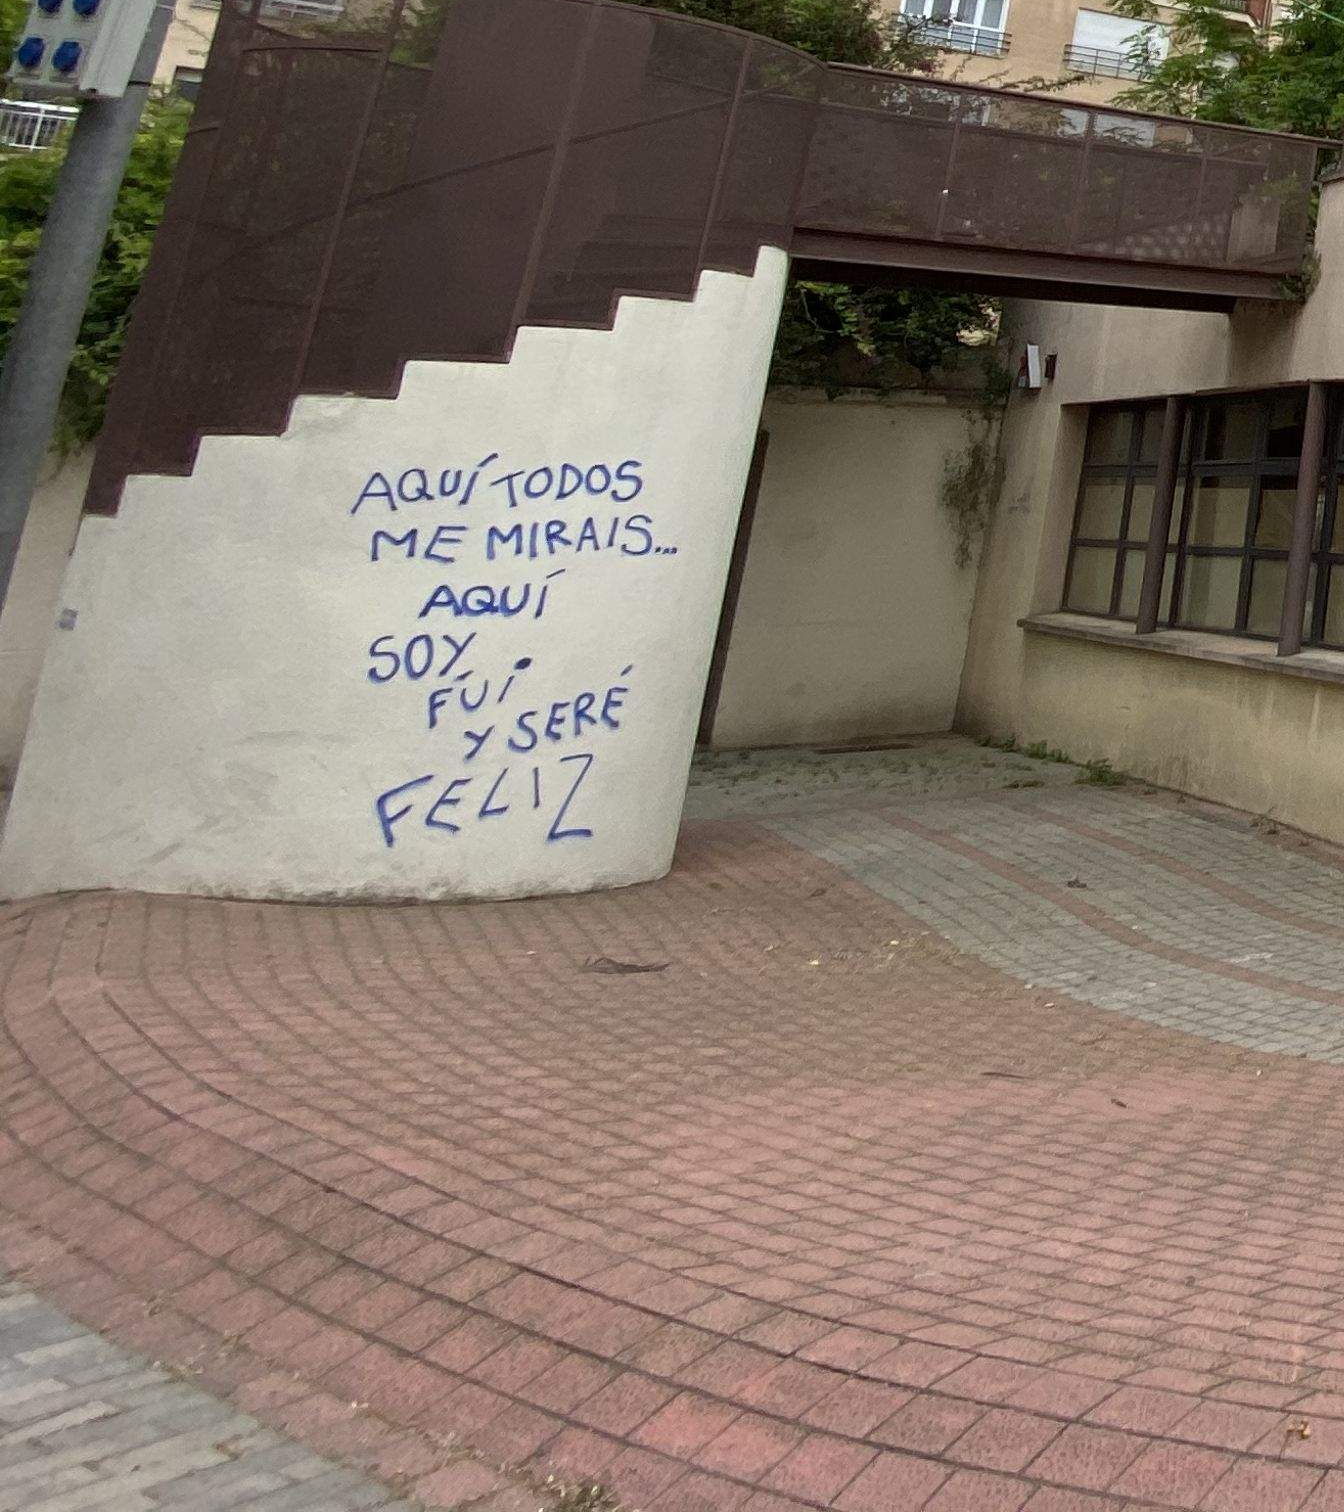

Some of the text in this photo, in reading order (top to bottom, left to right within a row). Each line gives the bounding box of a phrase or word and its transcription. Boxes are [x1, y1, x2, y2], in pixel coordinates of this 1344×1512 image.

[351, 452, 645, 515] AQUÍ TODOS
[370, 513, 679, 564] ME MIRAIS...
[417, 568, 567, 620] AQUÍ
[463, 664, 634, 764] Y SERÉ
[374, 752, 594, 849] FELIZ
